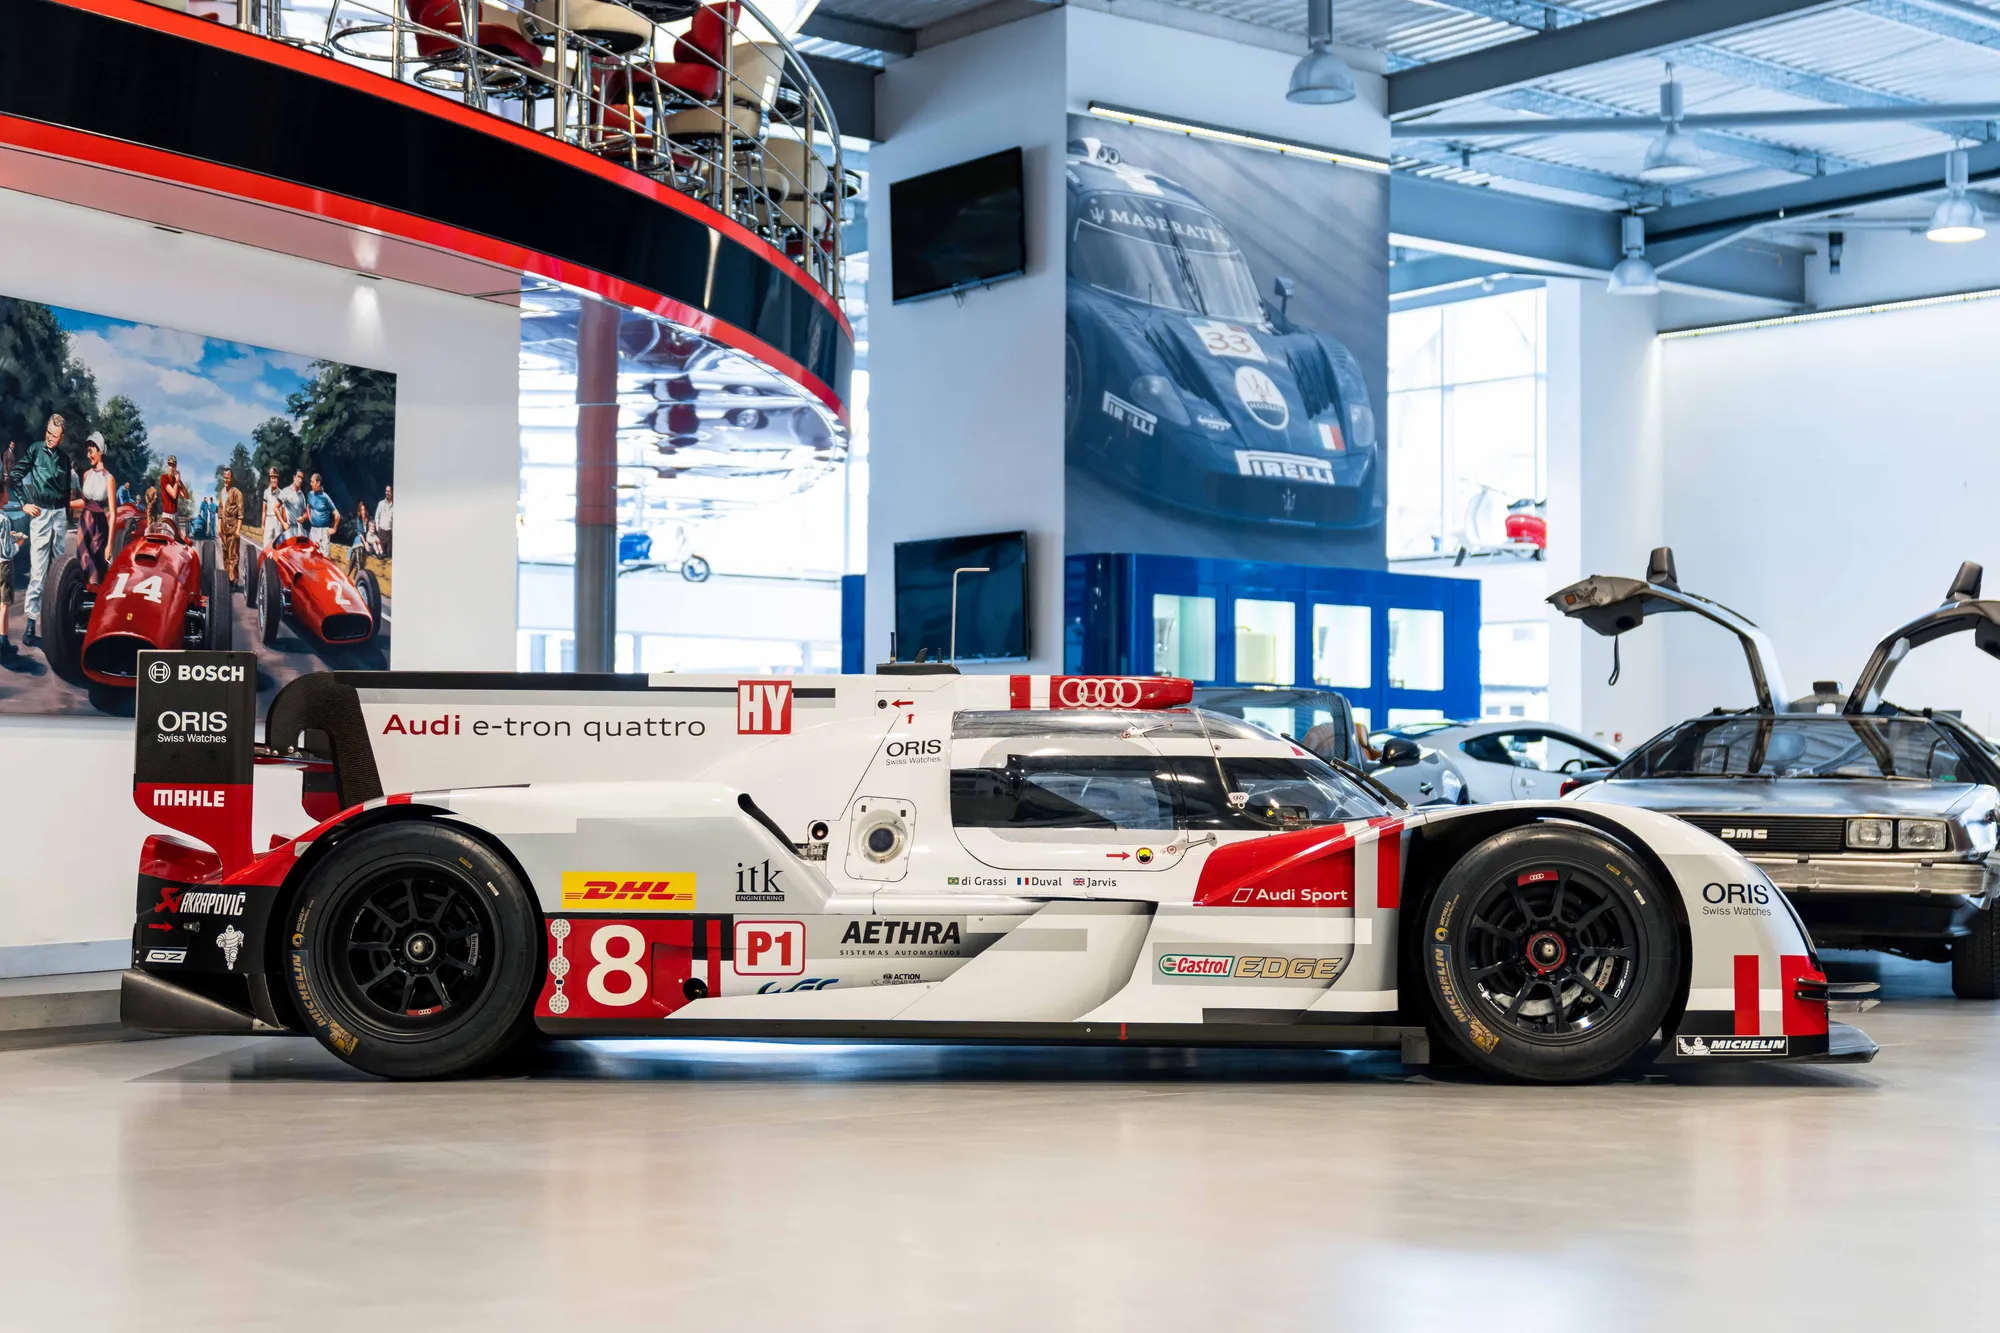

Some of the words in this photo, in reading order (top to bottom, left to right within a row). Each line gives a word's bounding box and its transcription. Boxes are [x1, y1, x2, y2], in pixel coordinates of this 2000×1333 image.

[1206, 332, 1251, 353] 33
[1234, 450, 1335, 485] PIRELLI
[105, 573, 163, 604] 14
[326, 581, 351, 605] 2
[178, 665, 244, 682] BOSCH
[739, 685, 790, 731] HY
[157, 711, 227, 732] ORIS
[382, 714, 460, 735] Audi
[472, 717, 571, 736] e-tron
[583, 717, 706, 742] quattro
[157, 733, 184, 743] Swiss
[187, 733, 227, 743] Watches
[886, 739, 942, 758] ORIS
[885, 757, 907, 766] Swiss
[908, 755, 941, 765] Watches
[153, 789, 225, 807] MAHLE
[735, 859, 785, 893] itk
[961, 876, 971, 886] di
[974, 876, 1007, 886] Grassi
[1031, 876, 1062, 886] Duval
[1086, 877, 1117, 888] Jarvis
[582, 881, 677, 900] DHL
[1256, 888, 1296, 901] Audi
[1301, 888, 1348, 904] Sport
[1702, 882, 1769, 905] ORIS
[1702, 906, 1730, 916] Swiss
[1733, 906, 1772, 916] Watches
[841, 921, 960, 945] AETHRA
[747, 931, 792, 967] P1
[586, 924, 648, 1006] 8
[1177, 957, 1229, 974] Castrol
[1234, 956, 1343, 979] EDGE
[291, 954, 328, 1028] MICHELIN
[1435, 948, 1468, 1023] MICHELIN
[1710, 1038, 1786, 1052] MICHELIN
